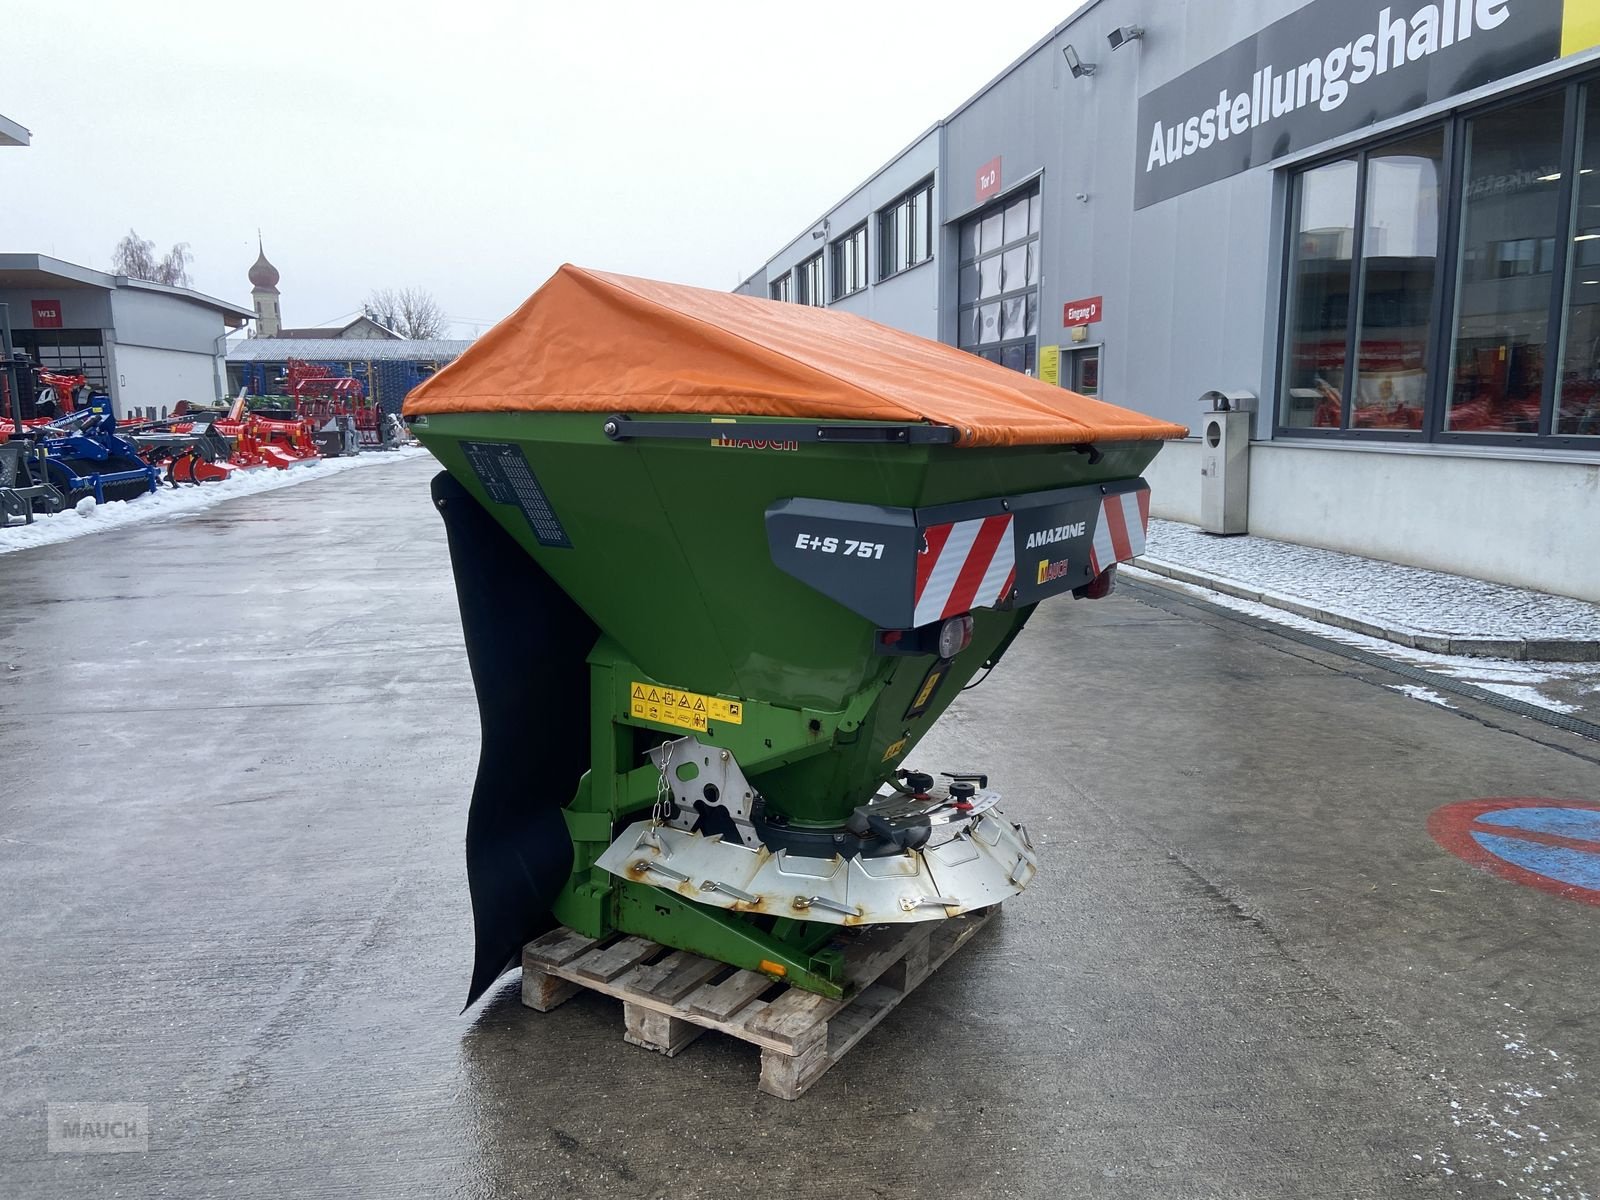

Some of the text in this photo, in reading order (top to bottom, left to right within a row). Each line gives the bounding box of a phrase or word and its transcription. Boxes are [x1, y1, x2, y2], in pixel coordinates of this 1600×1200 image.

[1146, 0, 1511, 173] Ausstellungshalle
[980, 170, 996, 190] Tor D
[37, 310, 56, 318] W13
[1068, 303, 1096, 321] Eingang D
[795, 533, 885, 560] E+S 751
[1025, 521, 1086, 550] AMAZONE
[1039, 558, 1069, 584] MAUCH
